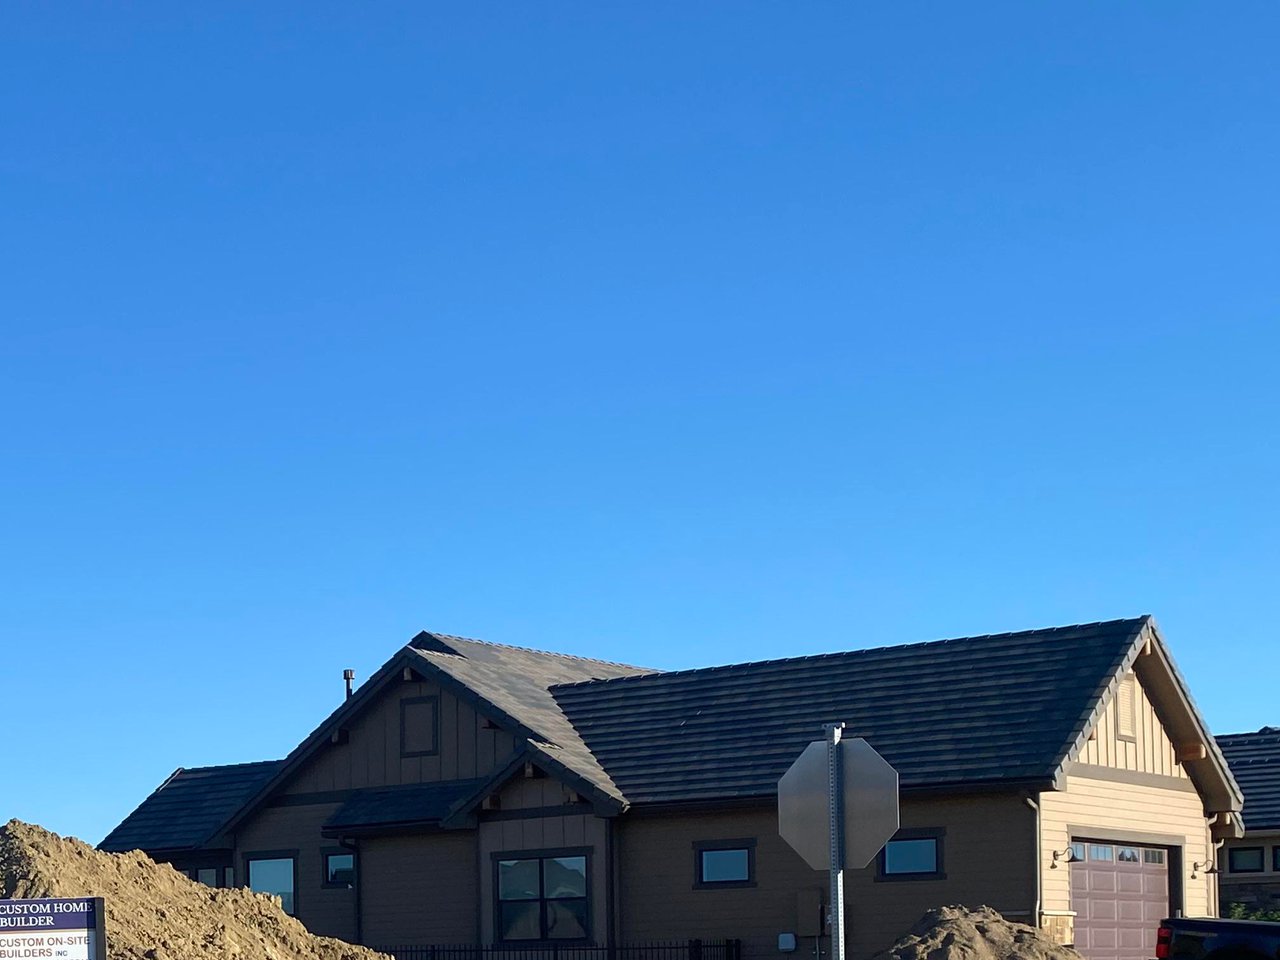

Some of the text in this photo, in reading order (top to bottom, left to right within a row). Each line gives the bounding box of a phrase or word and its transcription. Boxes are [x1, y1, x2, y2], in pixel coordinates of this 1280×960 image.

[54, 902, 92, 913] HOME
[0, 916, 54, 928] BUILDER
[0, 936, 91, 947] CUSTOM ON-SITE
[0, 948, 52, 958] BUILDERS
